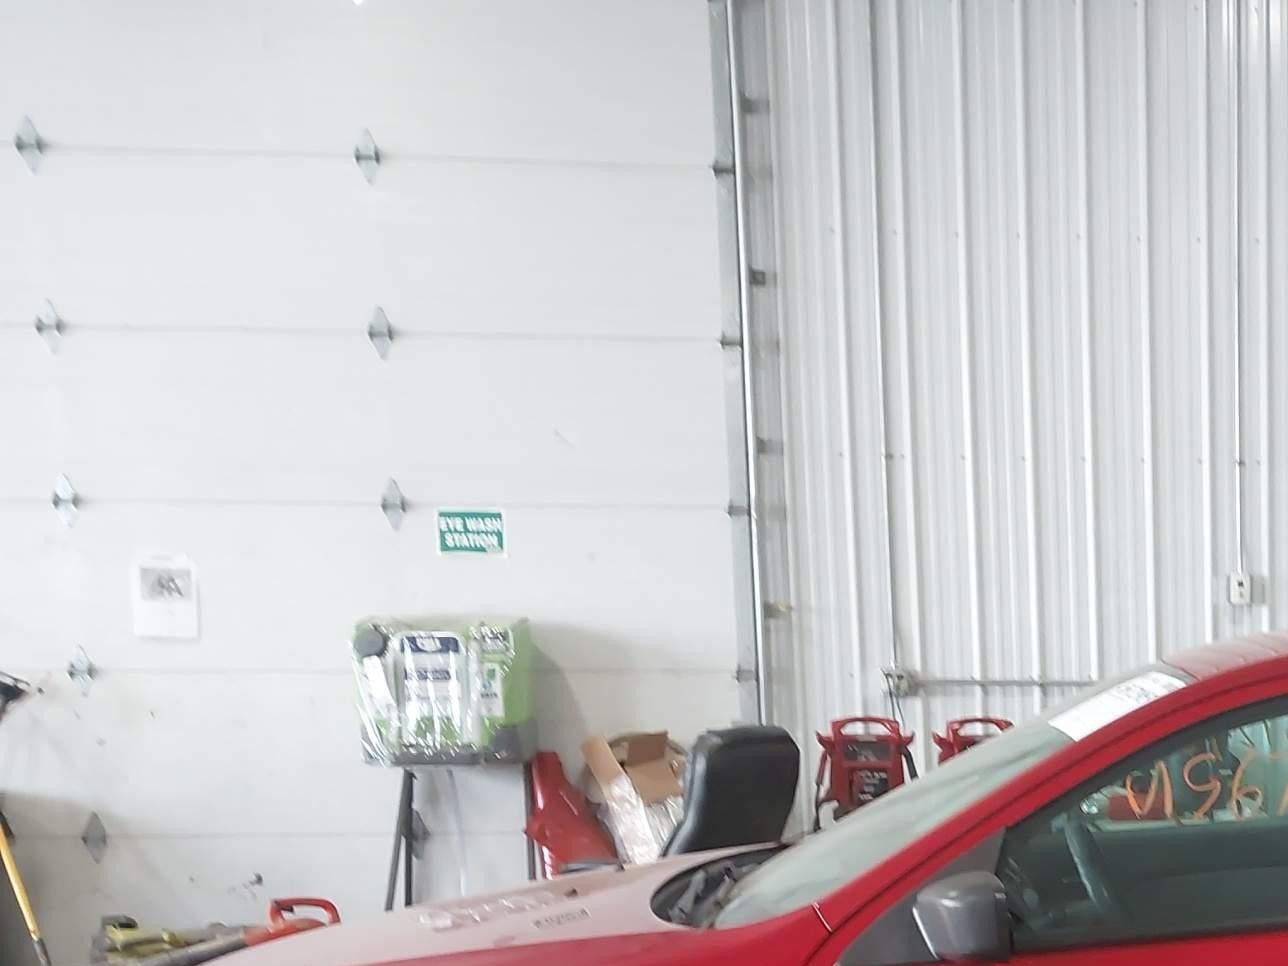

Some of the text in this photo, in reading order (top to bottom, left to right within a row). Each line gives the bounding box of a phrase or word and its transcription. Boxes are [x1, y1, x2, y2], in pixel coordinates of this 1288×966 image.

[439, 516, 503, 533] EYE WASH
[443, 531, 499, 549] STATION
